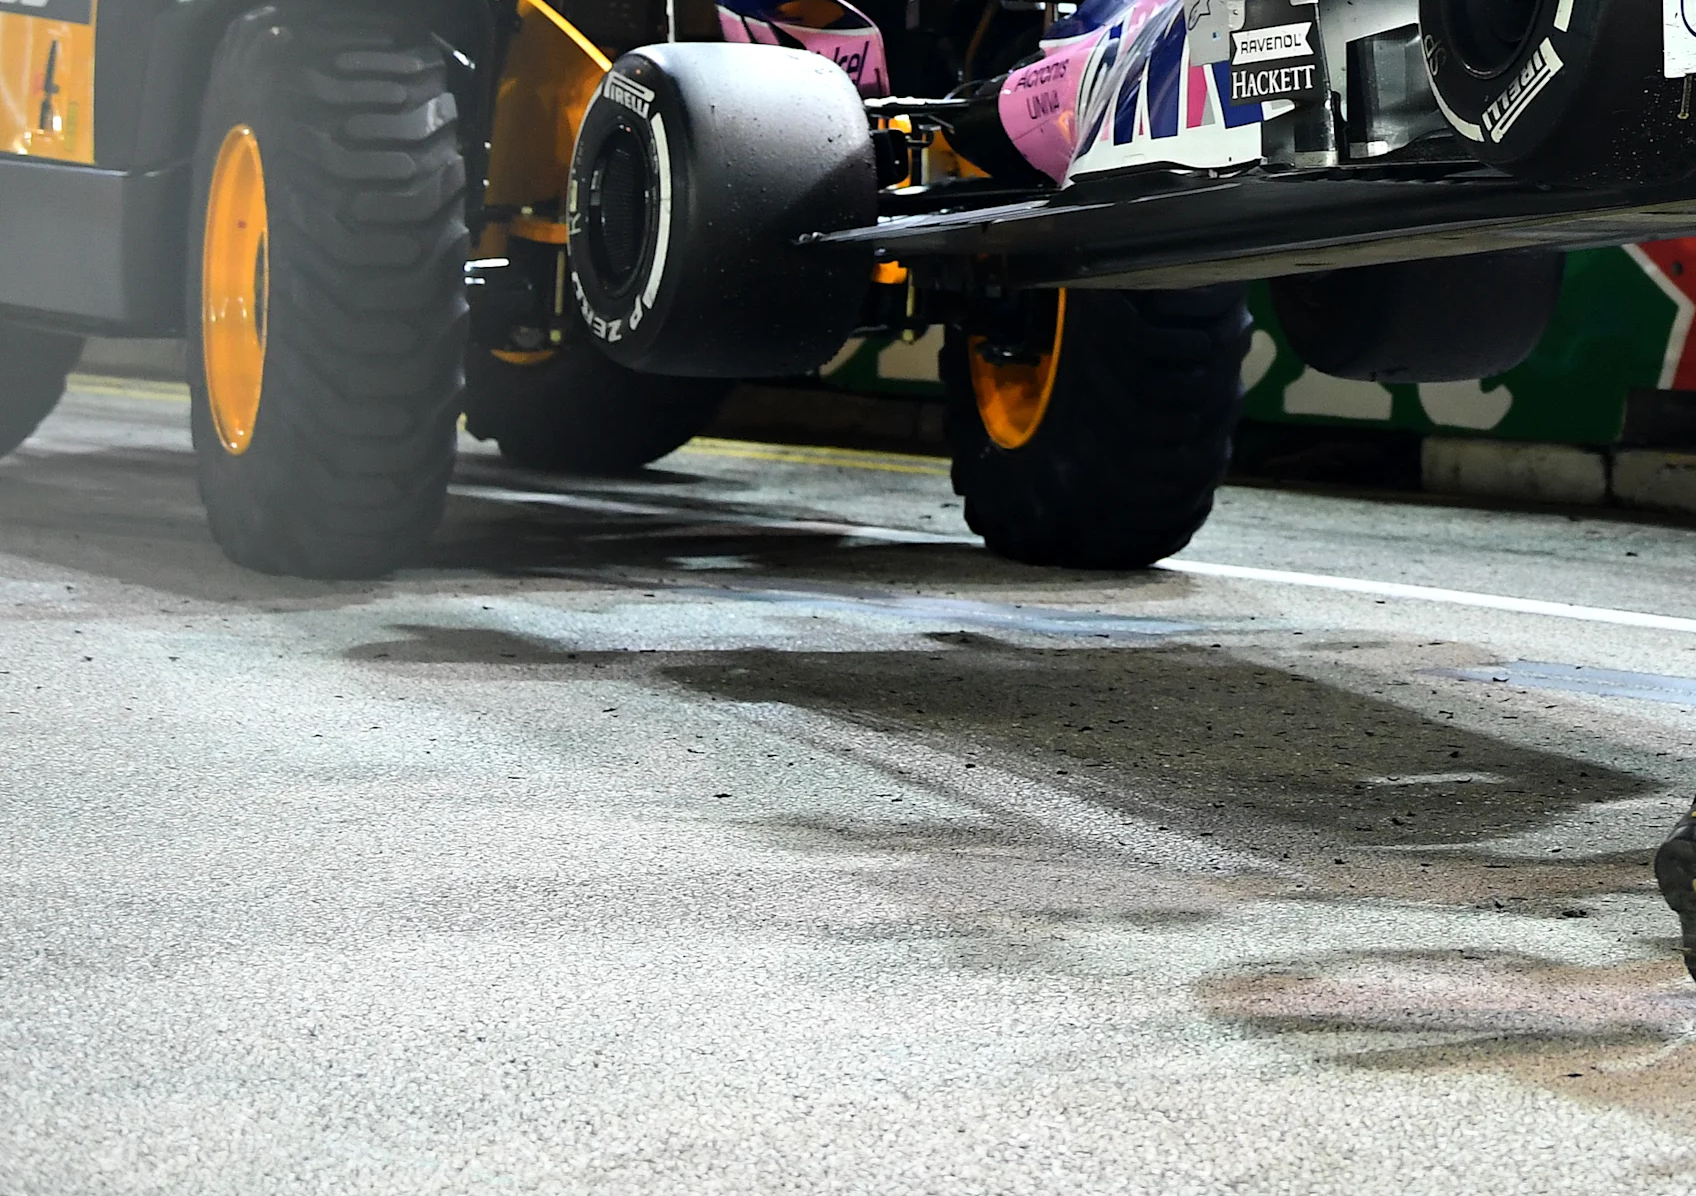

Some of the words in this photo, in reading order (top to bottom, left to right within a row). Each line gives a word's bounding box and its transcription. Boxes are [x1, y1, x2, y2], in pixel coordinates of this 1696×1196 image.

[1240, 34, 1301, 54] RAVENOL
[604, 71, 655, 120] PIRELLI
[1481, 37, 1564, 143] PIRELLI
